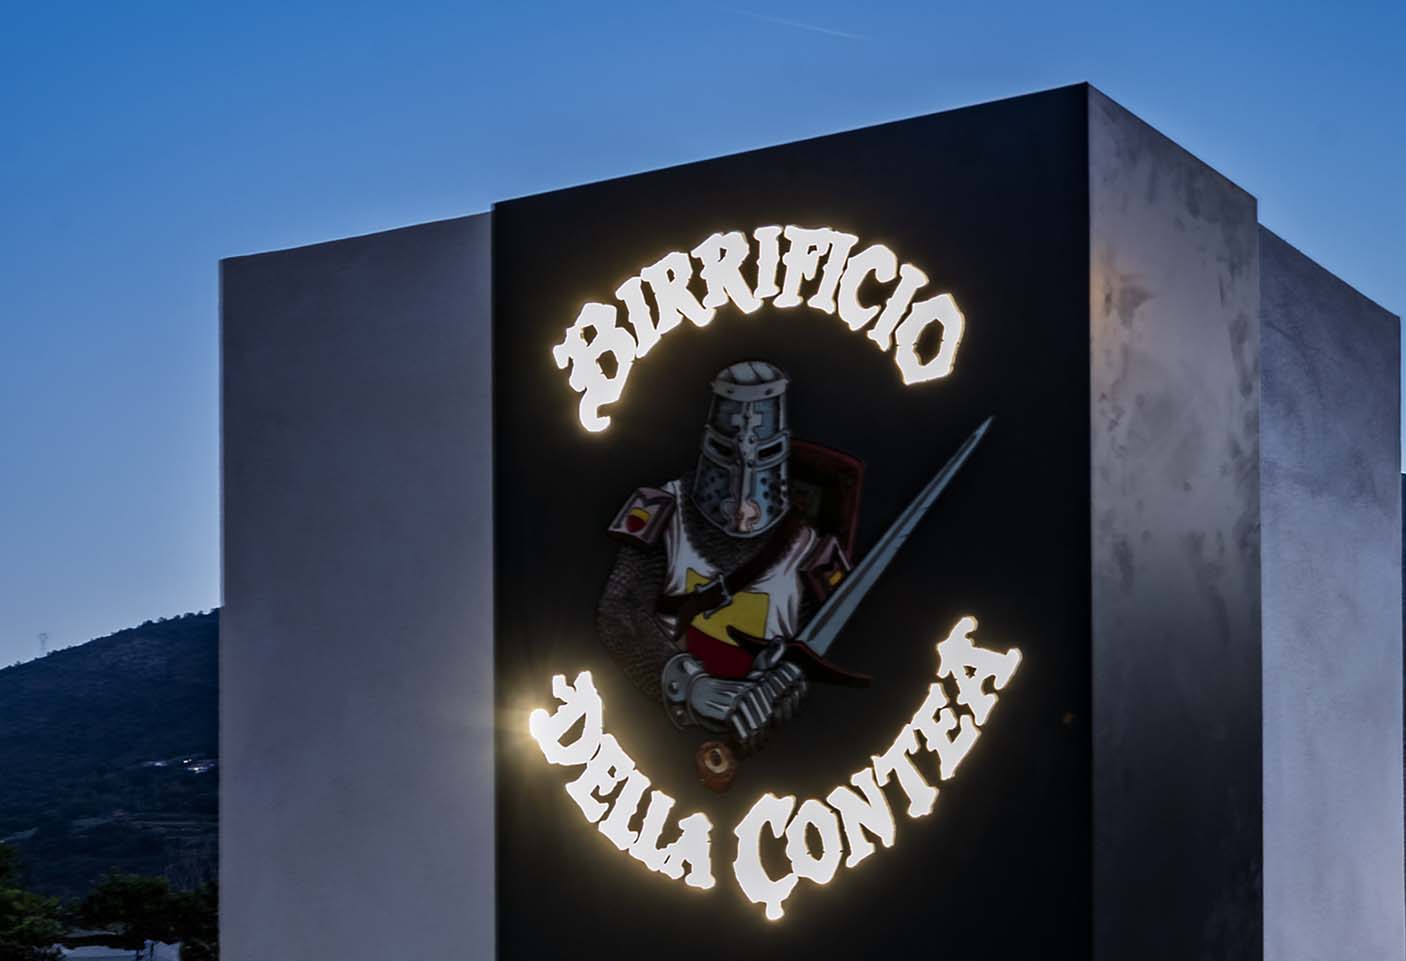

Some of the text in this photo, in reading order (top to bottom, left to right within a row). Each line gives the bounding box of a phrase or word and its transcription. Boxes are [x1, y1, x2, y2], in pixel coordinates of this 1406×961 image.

[552, 225, 966, 432] BIRRIFICIO
[528, 617, 1023, 921] DELLA CONTEA
